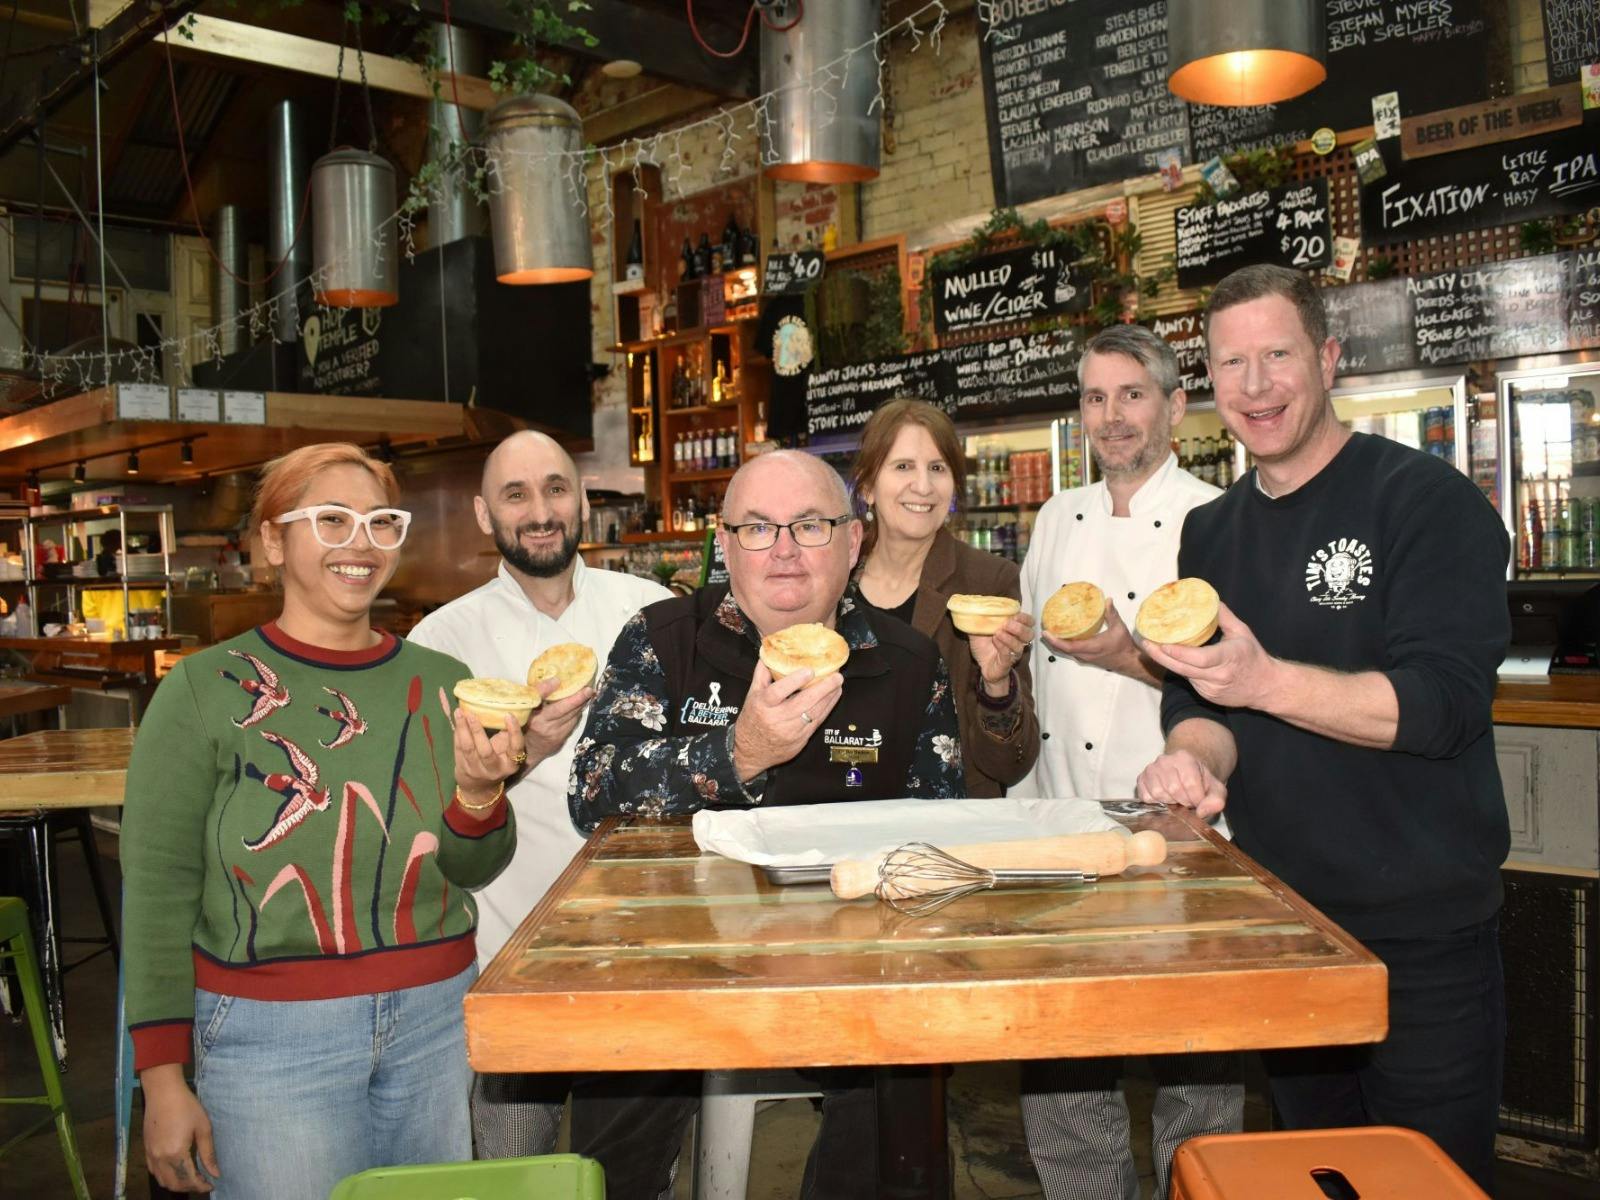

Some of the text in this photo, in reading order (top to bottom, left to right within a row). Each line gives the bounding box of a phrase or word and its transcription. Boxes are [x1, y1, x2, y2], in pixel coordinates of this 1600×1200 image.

[1105, 10, 1136, 31] STEVE
[1328, 9, 1384, 34] STEFAN
[1329, 14, 1452, 52] BEN SPELLER
[995, 77, 1018, 95] MATT
[998, 89, 1026, 109] STEVE
[999, 103, 1038, 123] CLAUDIA
[1416, 97, 1564, 146] BEER OF THE WEEK
[1001, 117, 1110, 153] LACHLAN MORRISON
[1054, 133, 1101, 155] DRIVER
[1355, 147, 1380, 168] IPA
[1502, 149, 1549, 171] LITTLE
[1508, 165, 1546, 187] RAY
[1548, 153, 1598, 190] IPA
[1177, 205, 1215, 228] STAFF
[1276, 212, 1293, 231] 4
[1294, 208, 1326, 230] PACK
[1280, 234, 1325, 265] $20
[788, 251, 821, 279] $40
[944, 264, 1012, 299] MULLED
[1031, 250, 1056, 269] $11
[1406, 273, 1457, 297] AUNTY
[944, 291, 1048, 323] WINE/CIDER
[322, 308, 346, 329] HOP
[1153, 316, 1195, 338] AUNTY
[318, 323, 358, 352] TEMPLE
[1416, 328, 1453, 347] STONE
[1014, 344, 1051, 367] DARK
[1051, 340, 1075, 358] ALE
[808, 368, 841, 386] AUNTY
[841, 363, 877, 381] JACKS
[808, 415, 839, 434] STONE
[1305, 537, 1373, 592] TIM'S TOASTIES
[692, 700, 739, 715] DELIVERING
[697, 709, 729, 720] BETTER
[687, 714, 730, 727] BALLARAT
[824, 728, 841, 736] CITY OF
[824, 735, 864, 746] BALLARAT
